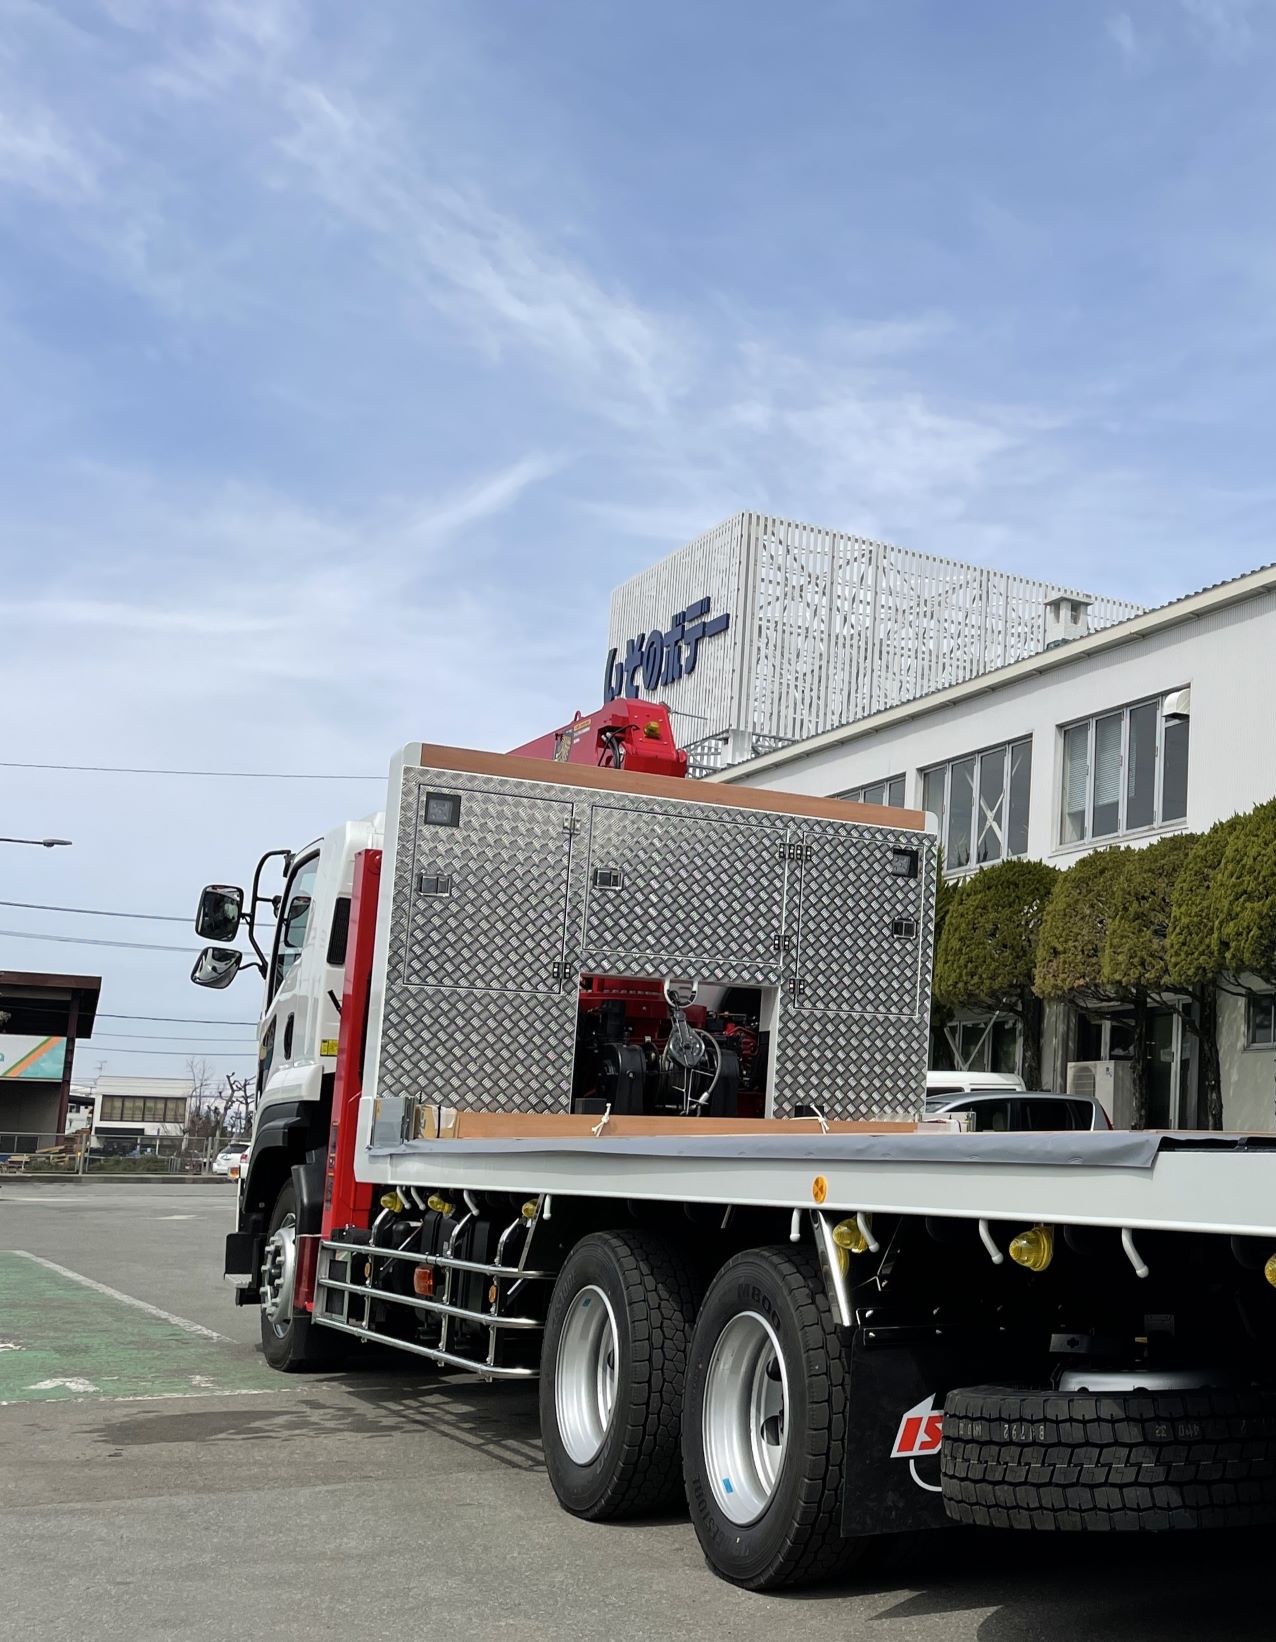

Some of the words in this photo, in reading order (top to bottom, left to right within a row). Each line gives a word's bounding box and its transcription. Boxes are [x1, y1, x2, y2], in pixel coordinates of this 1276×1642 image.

[603, 596, 730, 704] いそのボデー
